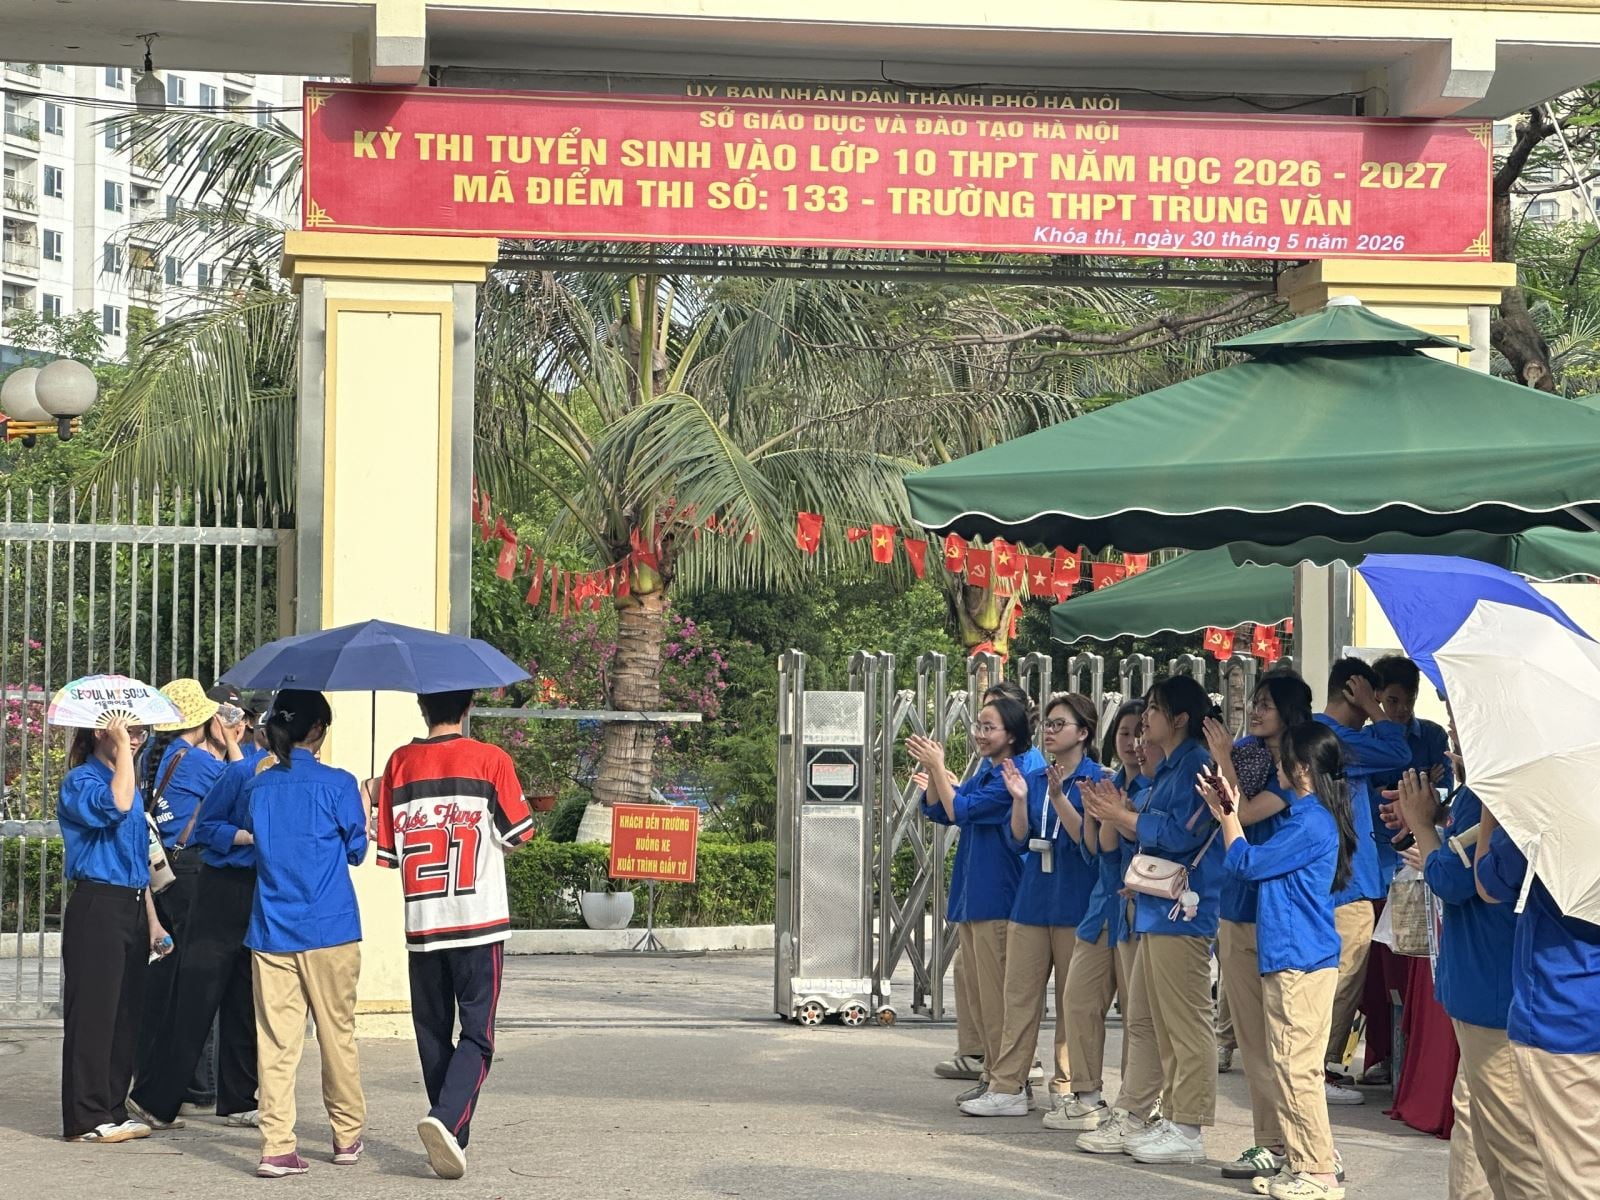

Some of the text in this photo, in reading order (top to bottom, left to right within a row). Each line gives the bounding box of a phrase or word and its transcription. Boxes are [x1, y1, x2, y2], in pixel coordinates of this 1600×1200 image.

[727, 86, 773, 99] BAN
[780, 85, 845, 101] NHÂN
[852, 87, 899, 103] DÂN
[906, 89, 985, 107] THÀNH
[992, 90, 1039, 108] PHỐ
[1044, 93, 1075, 110] HÀ
[700, 106, 1119, 144] SỞ GIÁO DỤC VÀ ĐÀO TẠO HÀ NỘI
[353, 126, 402, 160] KỲ
[414, 132, 474, 163] THI
[485, 126, 608, 166] TUYỂN
[619, 138, 712, 169] SINH
[723, 137, 798, 172] VÀO
[809, 140, 881, 174] LỚP
[893, 147, 938, 177] 10
[947, 149, 1041, 181] THPT
[1049, 149, 1137, 183] NĂM
[1148, 154, 1222, 191] HỌC
[1232, 157, 1322, 188] 2026
[1359, 161, 1448, 189] 2027
[453, 169, 515, 204] MÃ
[525, 165, 624, 207] ĐIỂM
[636, 179, 695, 209] THI
[707, 172, 769, 212] SỐ:
[783, 183, 849, 214] 133
[886, 182, 1037, 220] TRƯỜNG
[1046, 191, 1138, 222] THPT
[1147, 194, 1269, 225] TRUNG
[1279, 193, 1353, 227] VĂN
[1033, 226, 1405, 252] Khóa thi, ngày 30 tháng 5 năm 2026
[619, 812, 690, 831] KHÁCH ĐẾN TRƯỜNG
[635, 833, 671, 852] XUỐNG XE
[402, 823, 482, 902] 21
[617, 854, 688, 875] XUẤT TRÌNH GIẤY TỜ
